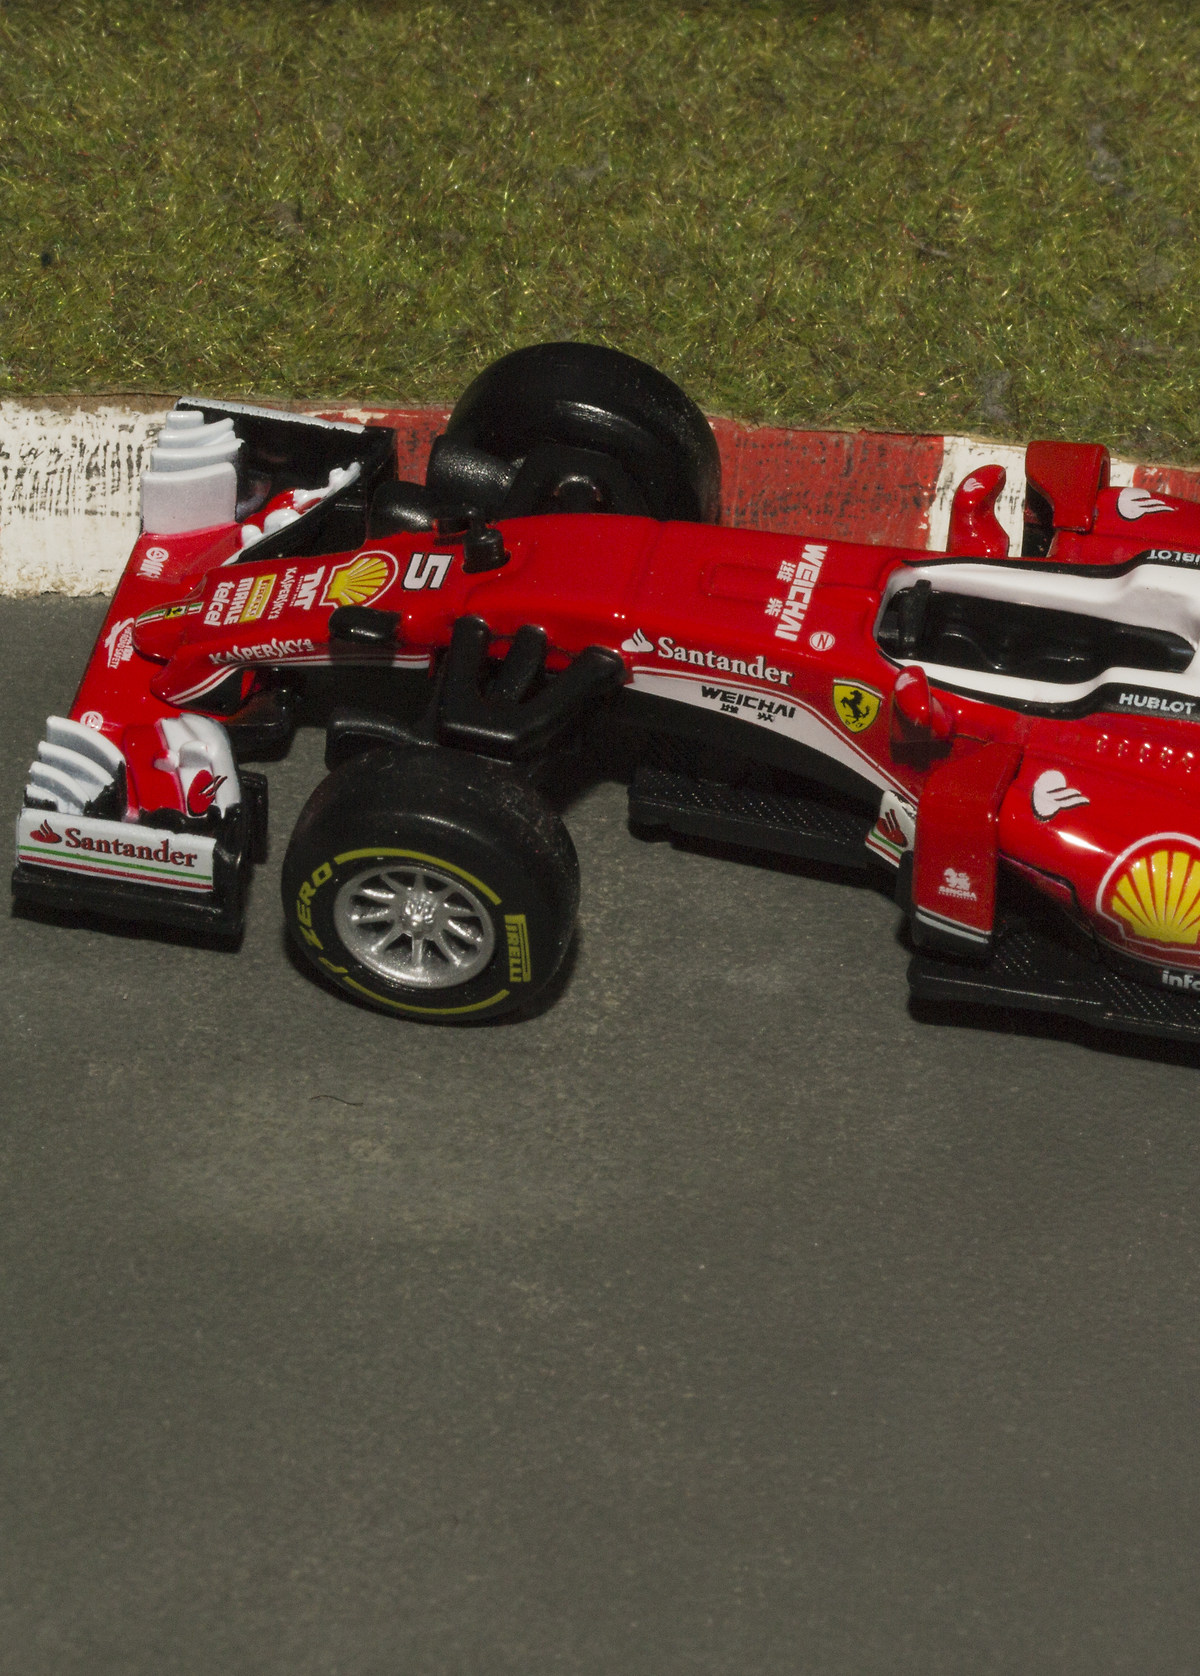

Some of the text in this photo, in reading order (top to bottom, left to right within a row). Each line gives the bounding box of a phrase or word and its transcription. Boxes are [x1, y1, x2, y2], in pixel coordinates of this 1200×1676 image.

[403, 552, 455, 591] 5
[774, 543, 829, 642] WEICHAI
[203, 581, 236, 627] telcel
[223, 577, 255, 626] MAHLE
[208, 637, 303, 665] KASPERSKY
[657, 636, 795, 686] Santander
[700, 685, 797, 719] WEICHAI
[1118, 692, 1197, 716] HUBLOT
[64, 827, 198, 868] Santander
[296, 861, 334, 950] ZERO
[504, 914, 532, 983] PIRELLI
